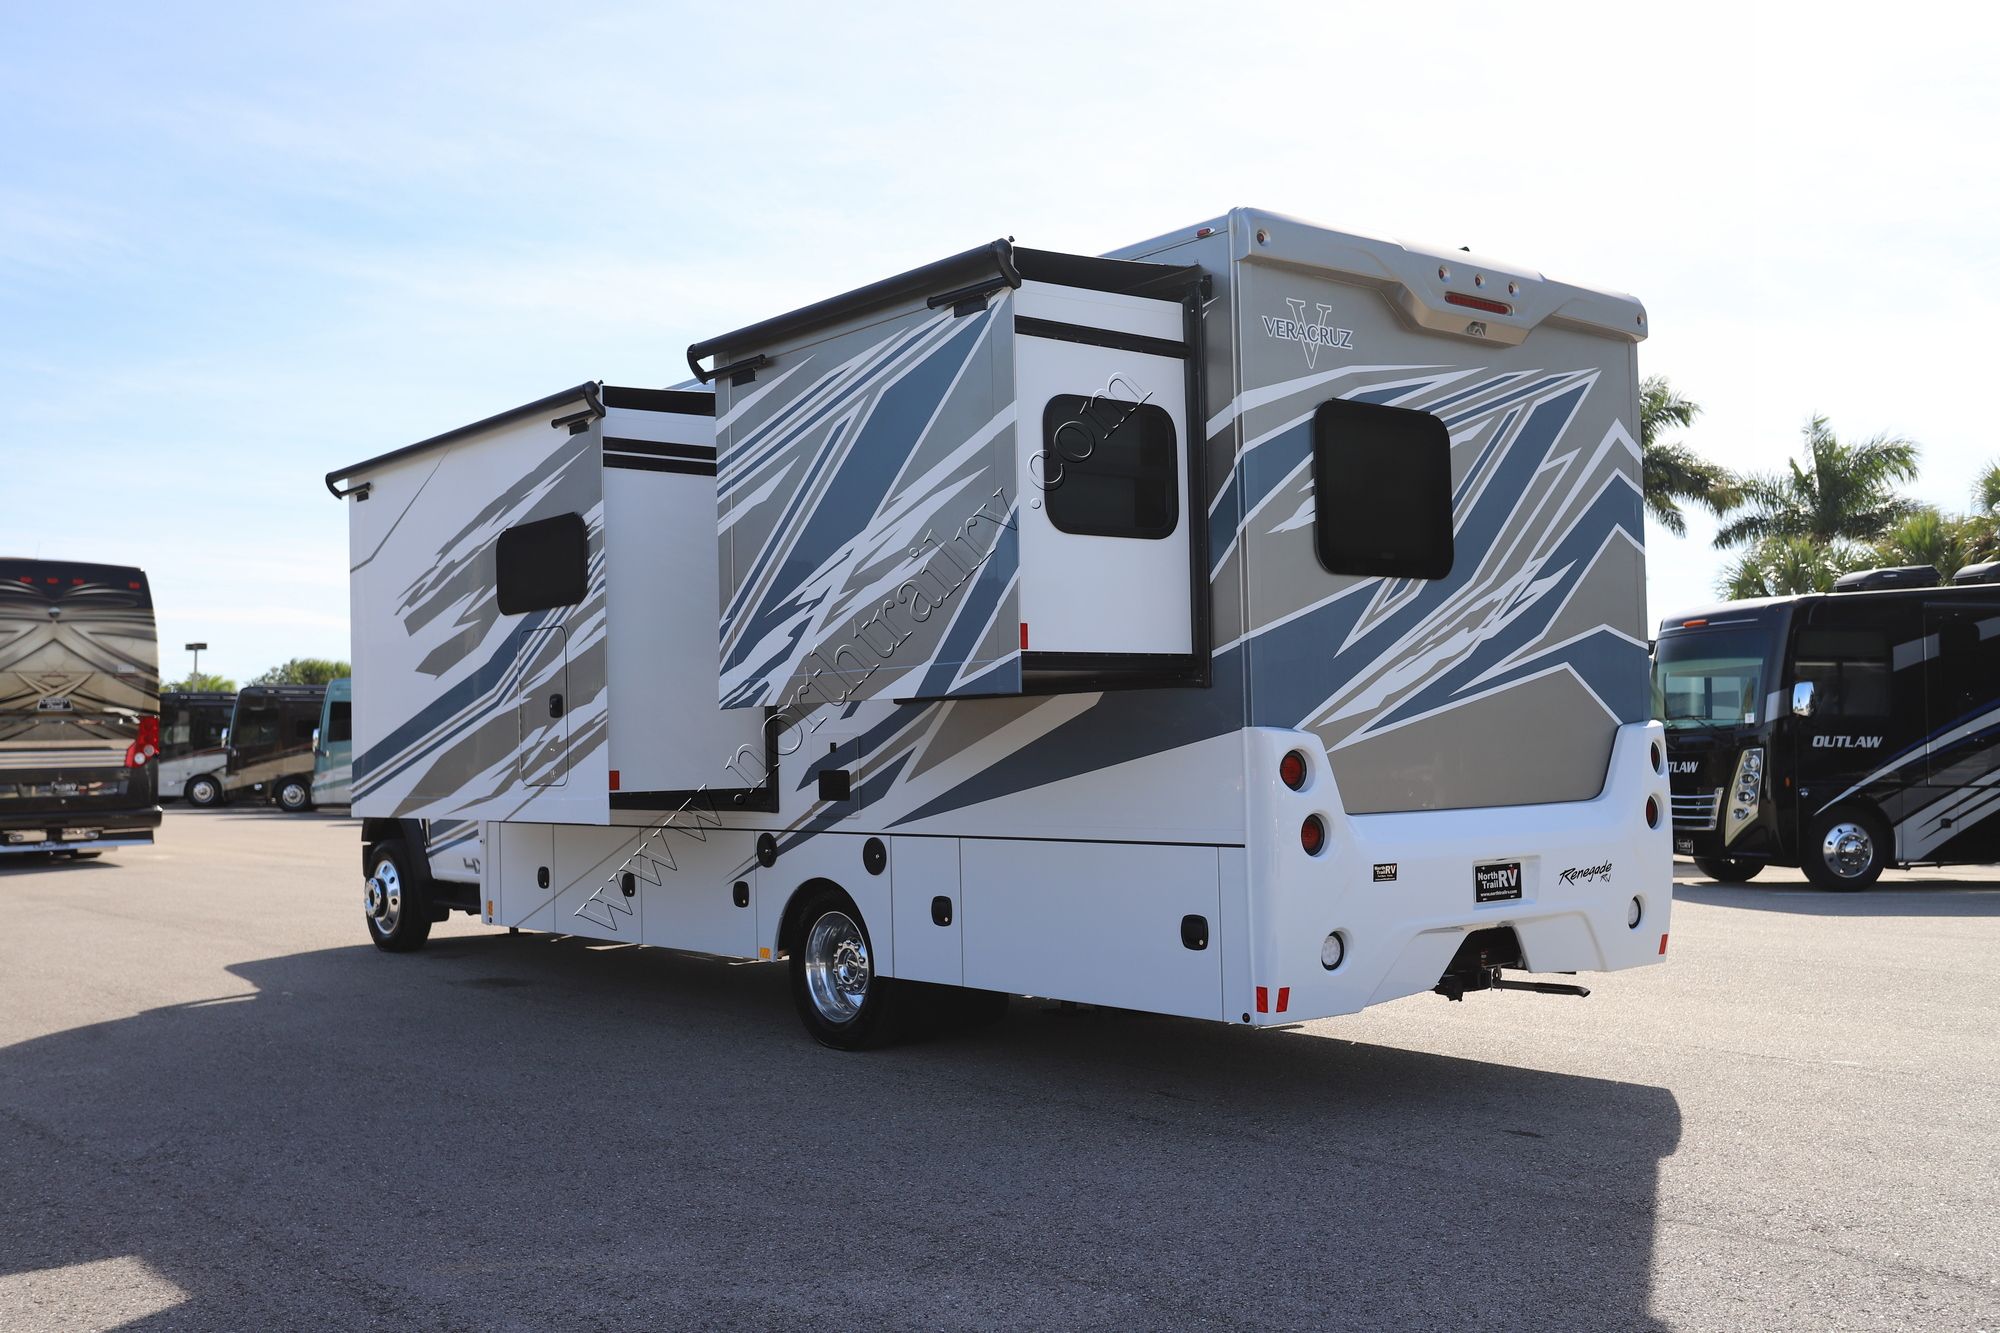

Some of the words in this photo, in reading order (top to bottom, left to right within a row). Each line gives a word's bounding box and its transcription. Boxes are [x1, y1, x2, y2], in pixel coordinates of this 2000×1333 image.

[1262, 315, 1353, 350] VERACRUZ
[1812, 735, 1883, 748] OUTLAW
[1668, 761, 1699, 773] TLAW
[1477, 871, 1498, 881] North
[1498, 869, 1518, 888] RV
[1558, 860, 1613, 886] Renegade
[1481, 879, 1499, 889] Trail
